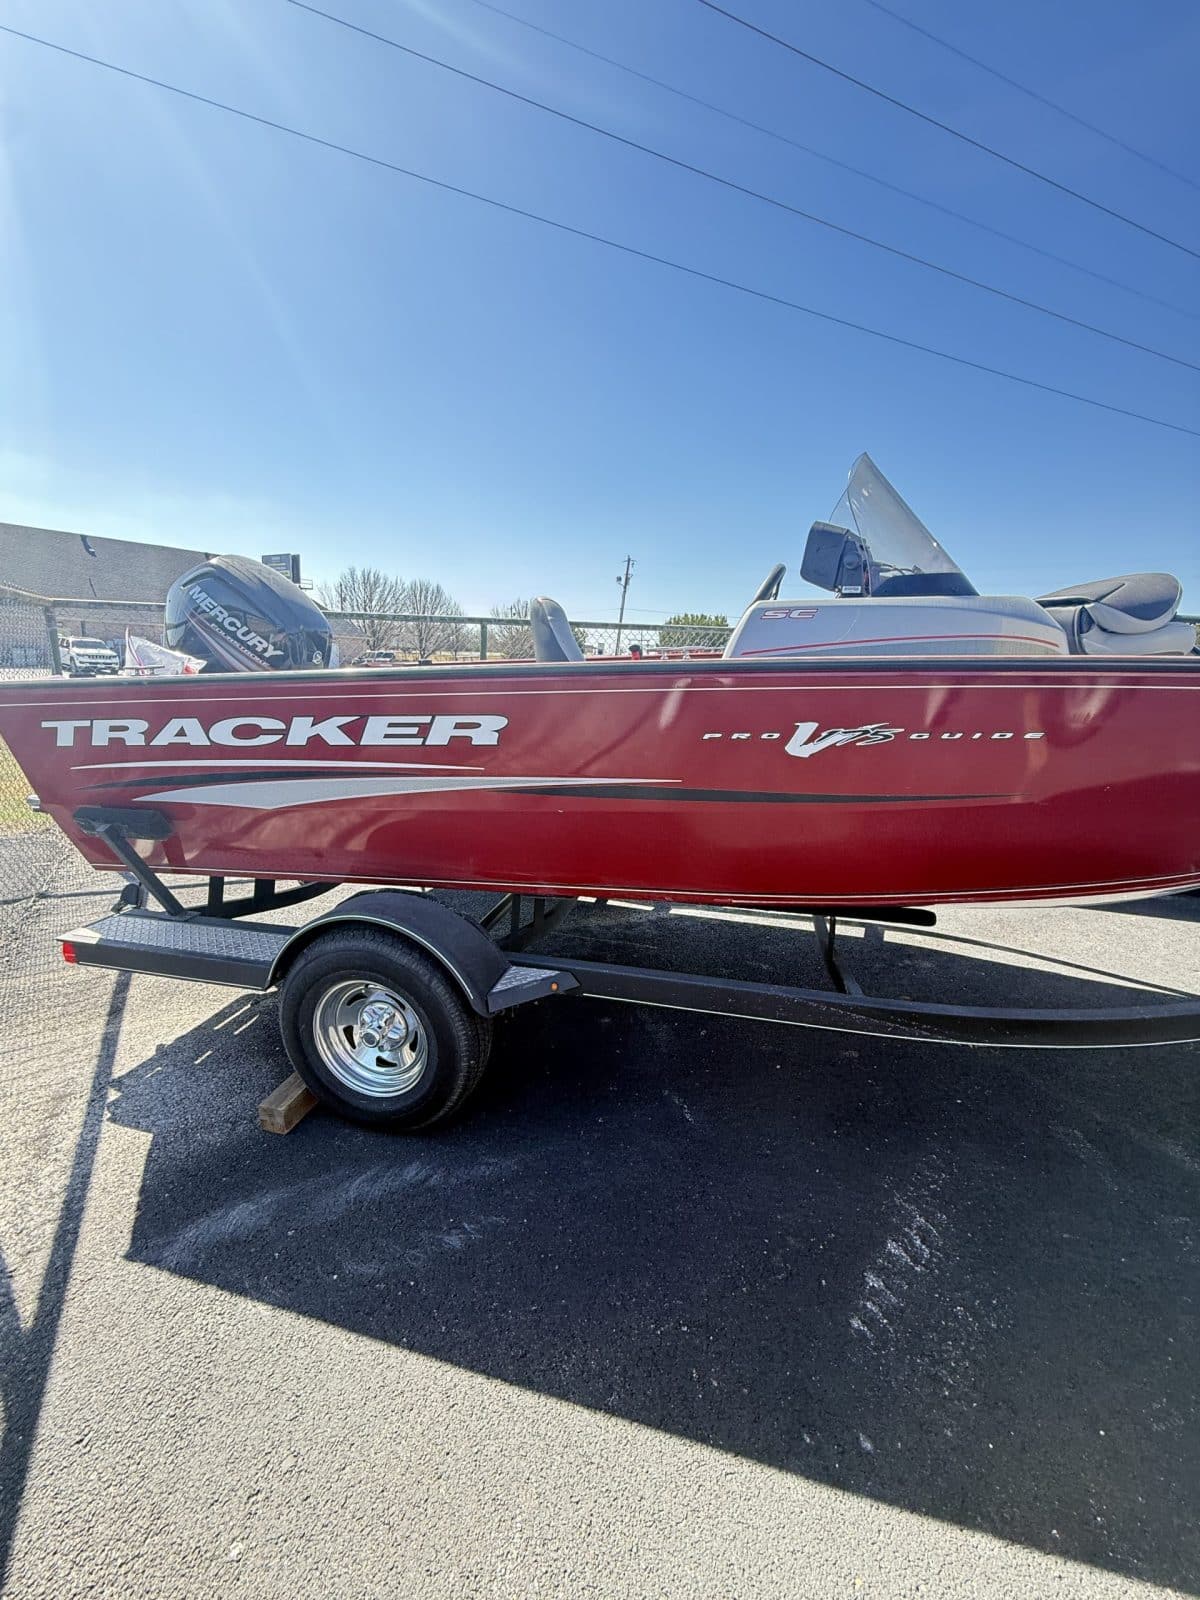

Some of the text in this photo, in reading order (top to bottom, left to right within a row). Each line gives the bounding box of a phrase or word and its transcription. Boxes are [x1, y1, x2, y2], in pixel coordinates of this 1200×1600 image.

[189, 585, 284, 658] MERCURY
[760, 608, 818, 620] SC
[40, 714, 509, 748] TRACKER
[702, 732, 781, 741] PRO
[909, 731, 1046, 741] GUIDE
